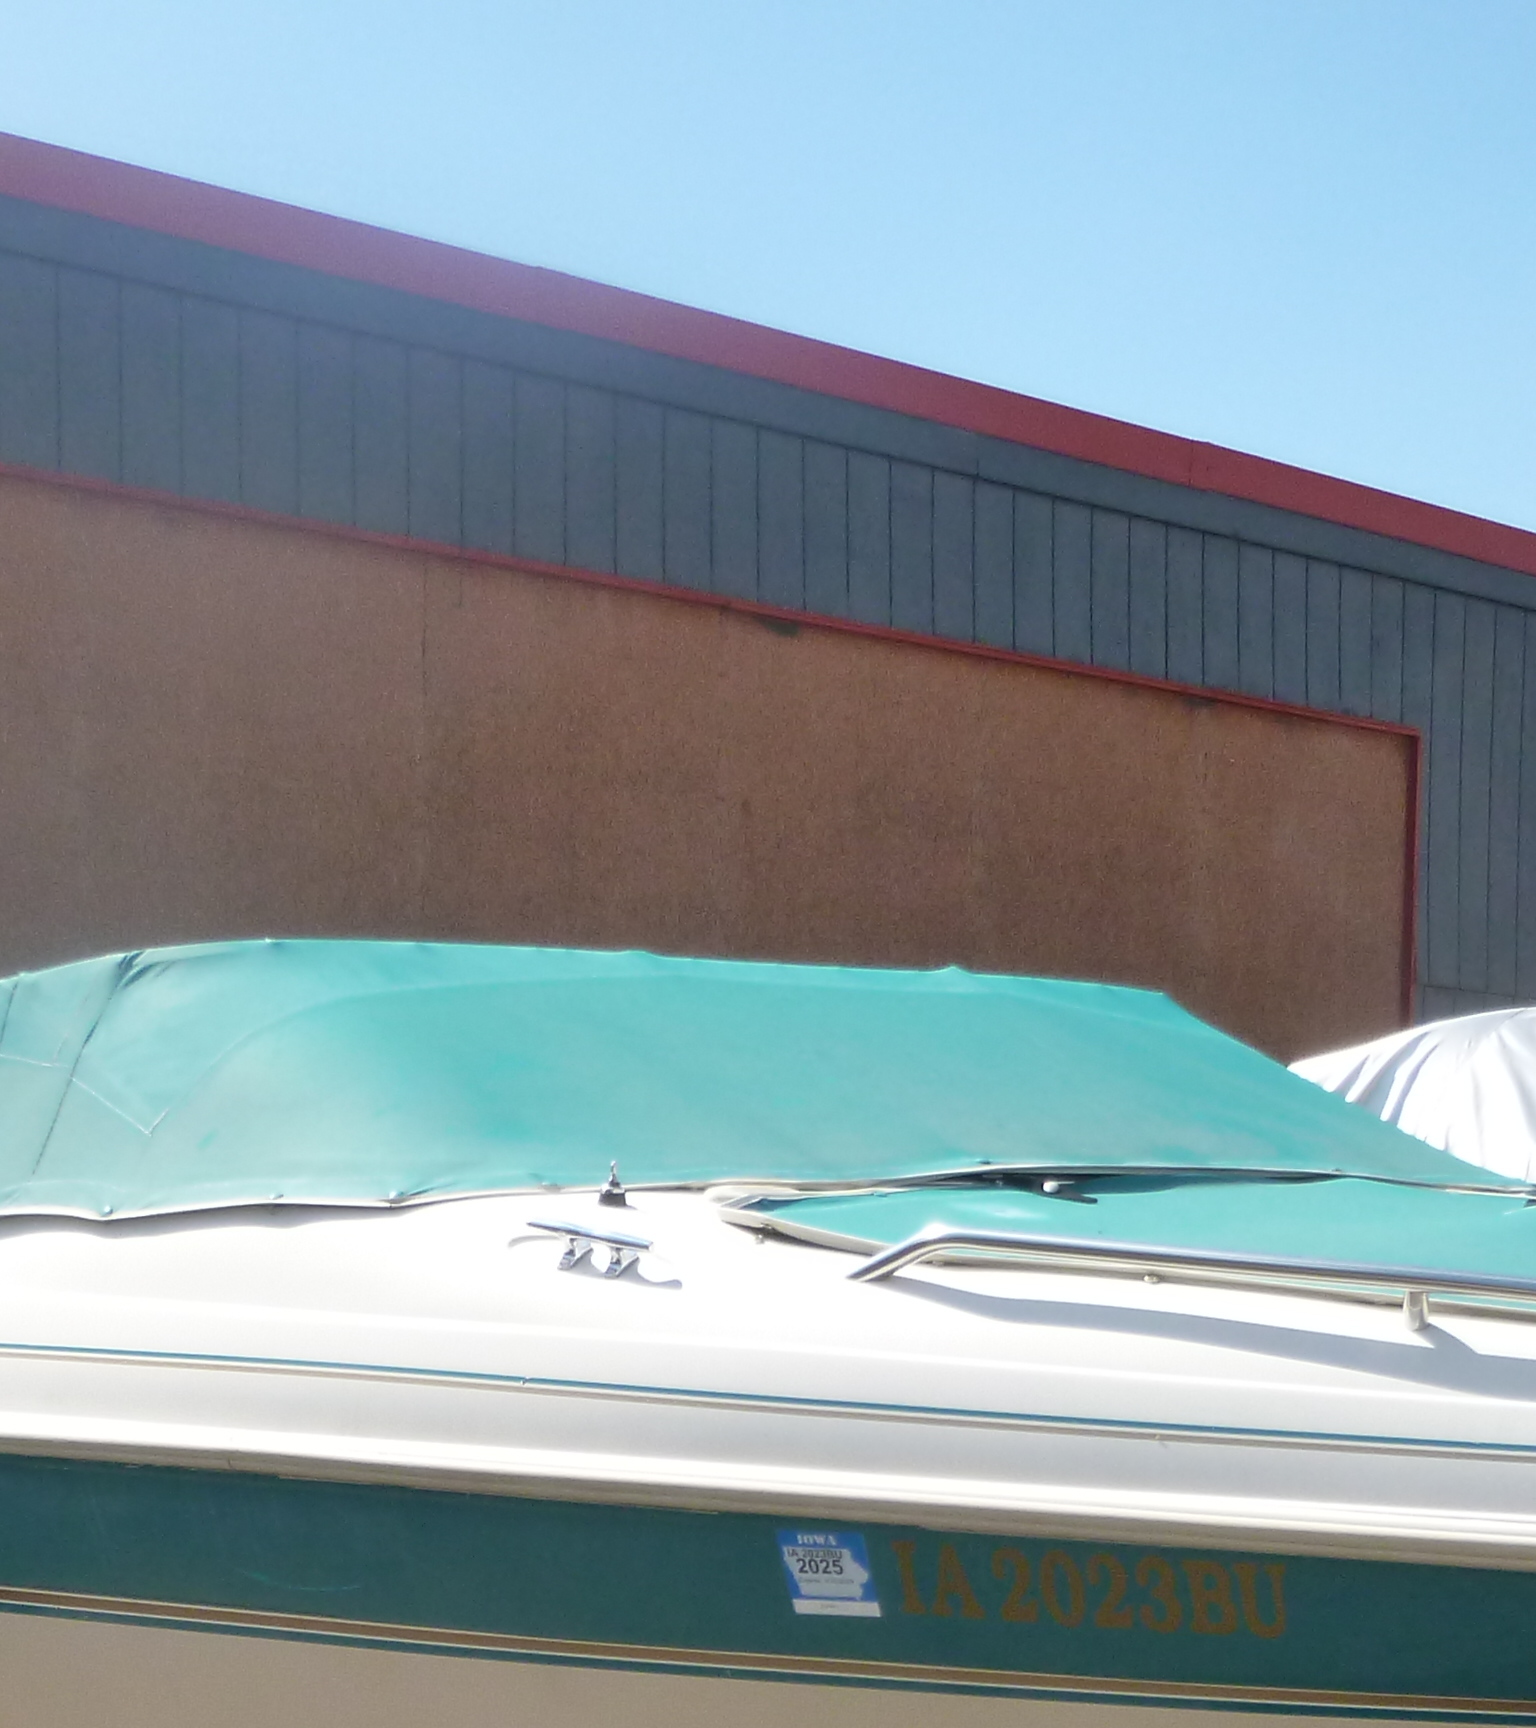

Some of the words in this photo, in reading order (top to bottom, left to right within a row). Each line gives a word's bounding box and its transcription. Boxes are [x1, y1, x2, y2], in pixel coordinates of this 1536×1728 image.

[796, 1534, 837, 1546] IOWA
[787, 1548, 799, 1557] IA
[796, 1558, 844, 1575] 2025
[893, 1539, 986, 1618] IA
[991, 1546, 1286, 1640] 2023BU
